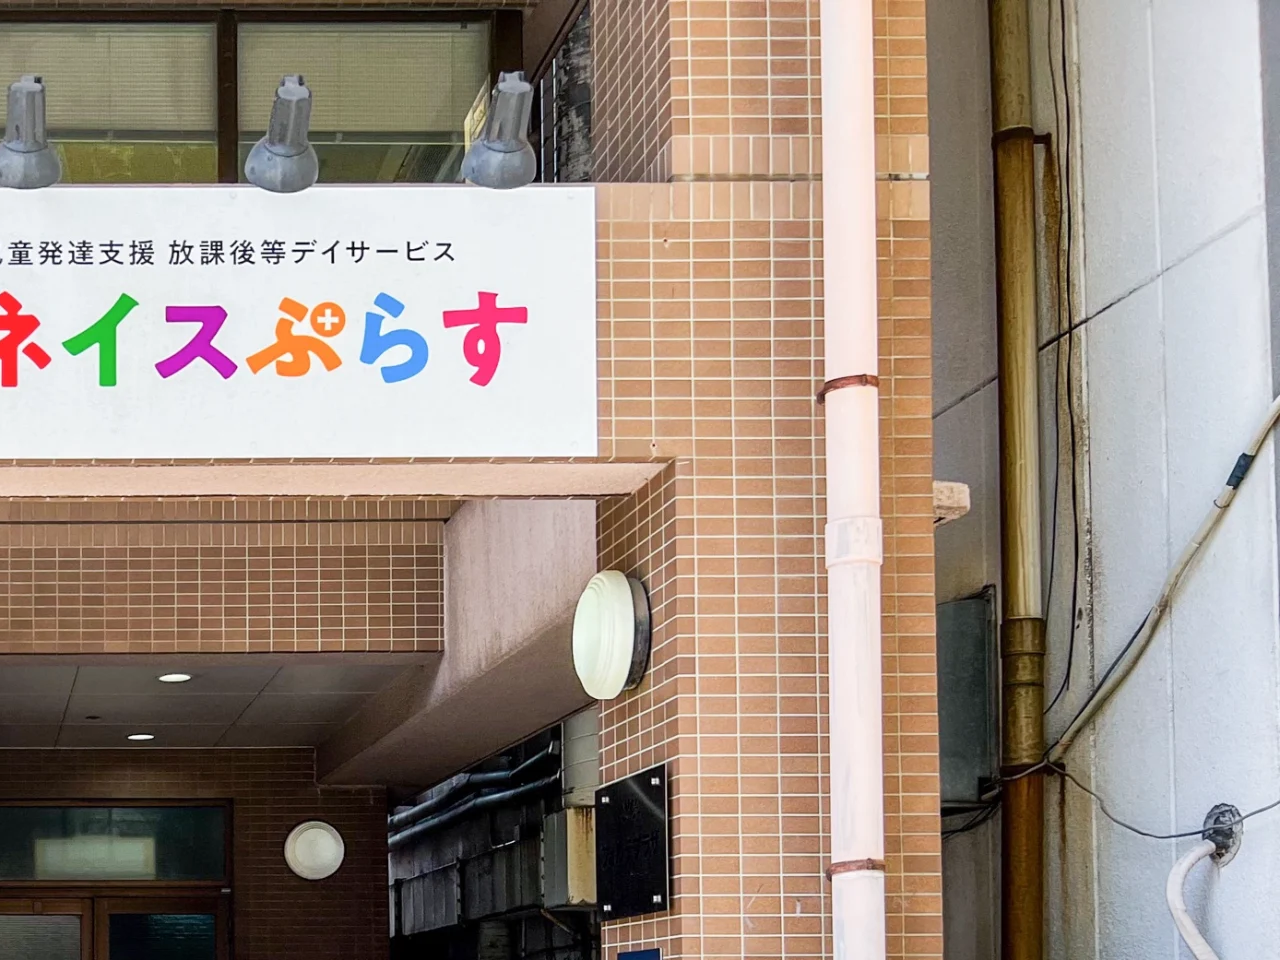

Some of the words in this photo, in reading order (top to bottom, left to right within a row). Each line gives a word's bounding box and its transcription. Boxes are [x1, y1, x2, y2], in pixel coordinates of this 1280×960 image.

[167, 239, 457, 267] 放課後等デイサービス
